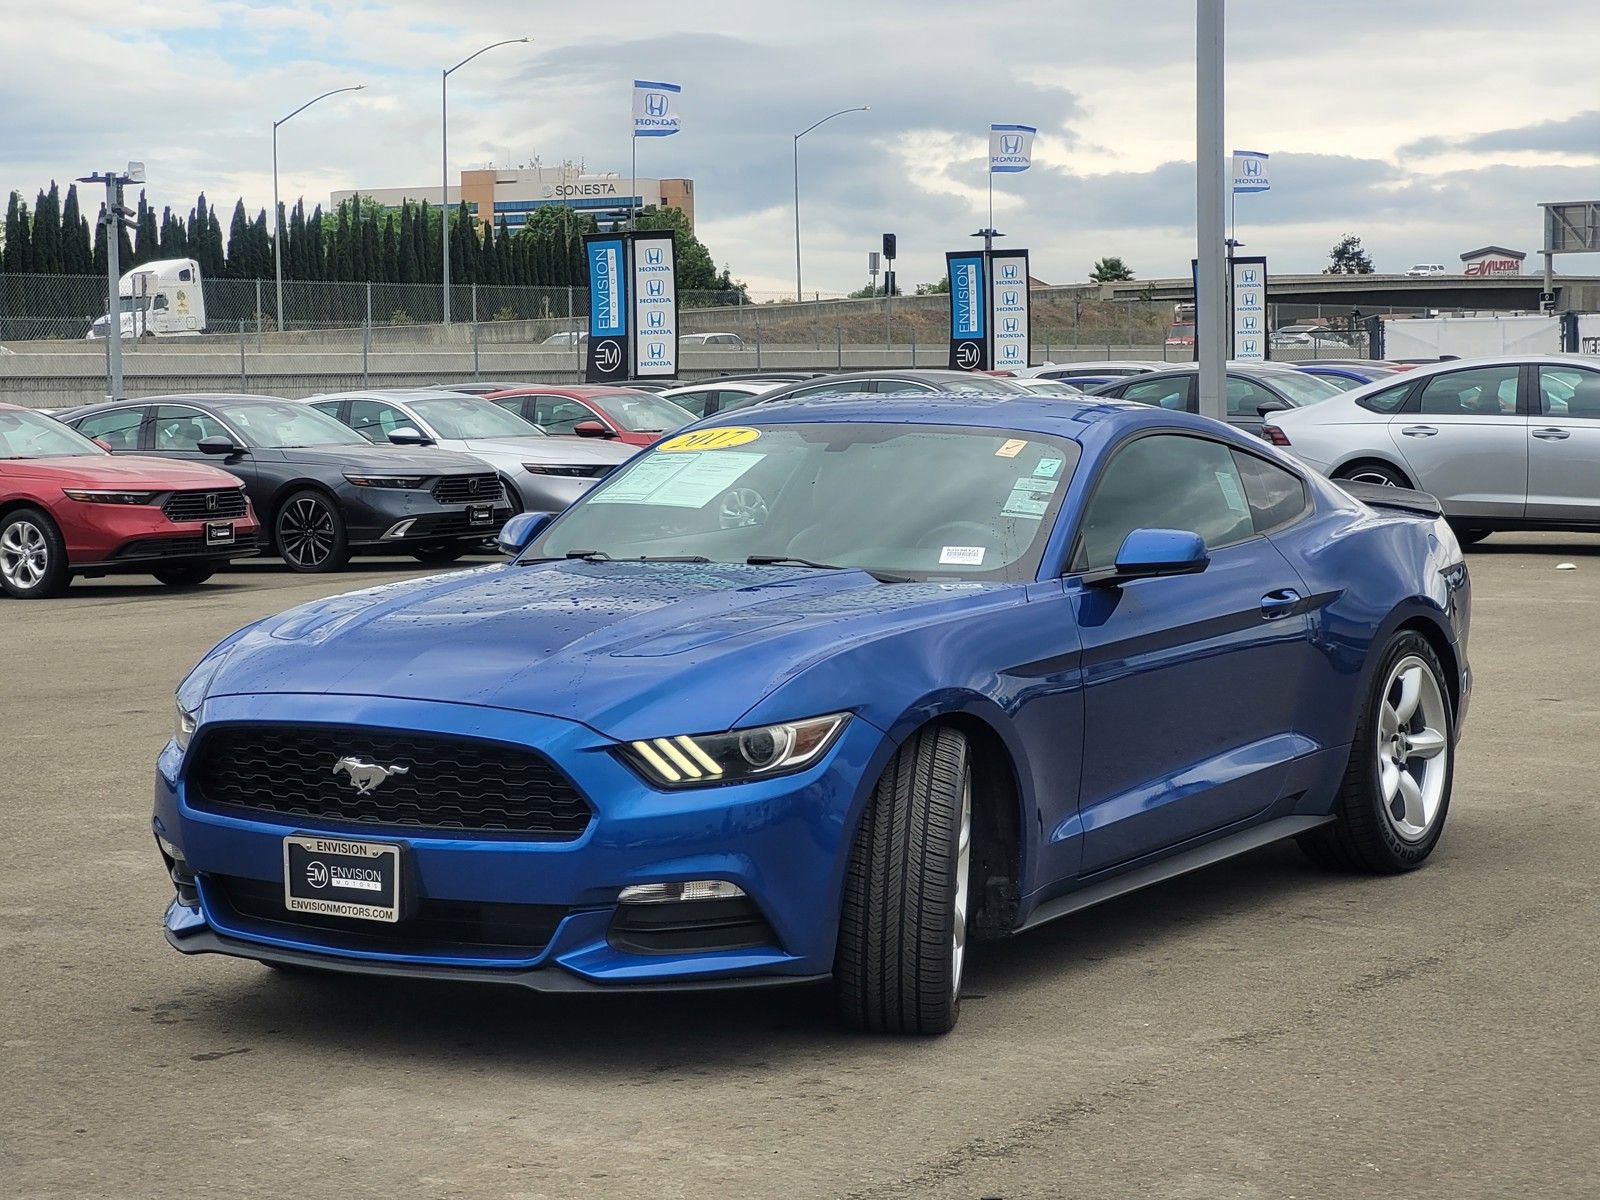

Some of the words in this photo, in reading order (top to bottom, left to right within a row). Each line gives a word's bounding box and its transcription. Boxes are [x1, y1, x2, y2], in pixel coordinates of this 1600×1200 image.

[634, 118, 678, 126] HONDA
[555, 183, 617, 196] SONESTA
[638, 265, 671, 273] HONDA
[594, 248, 610, 329] ENVISION
[956, 264, 970, 333] ENVISION
[667, 430, 749, 449] 2017
[316, 841, 367, 856] ENVISION
[330, 866, 382, 882] ENVISION
[335, 879, 378, 890] MOTORS
[291, 900, 393, 920] ENVISIONMOTORS.COM
